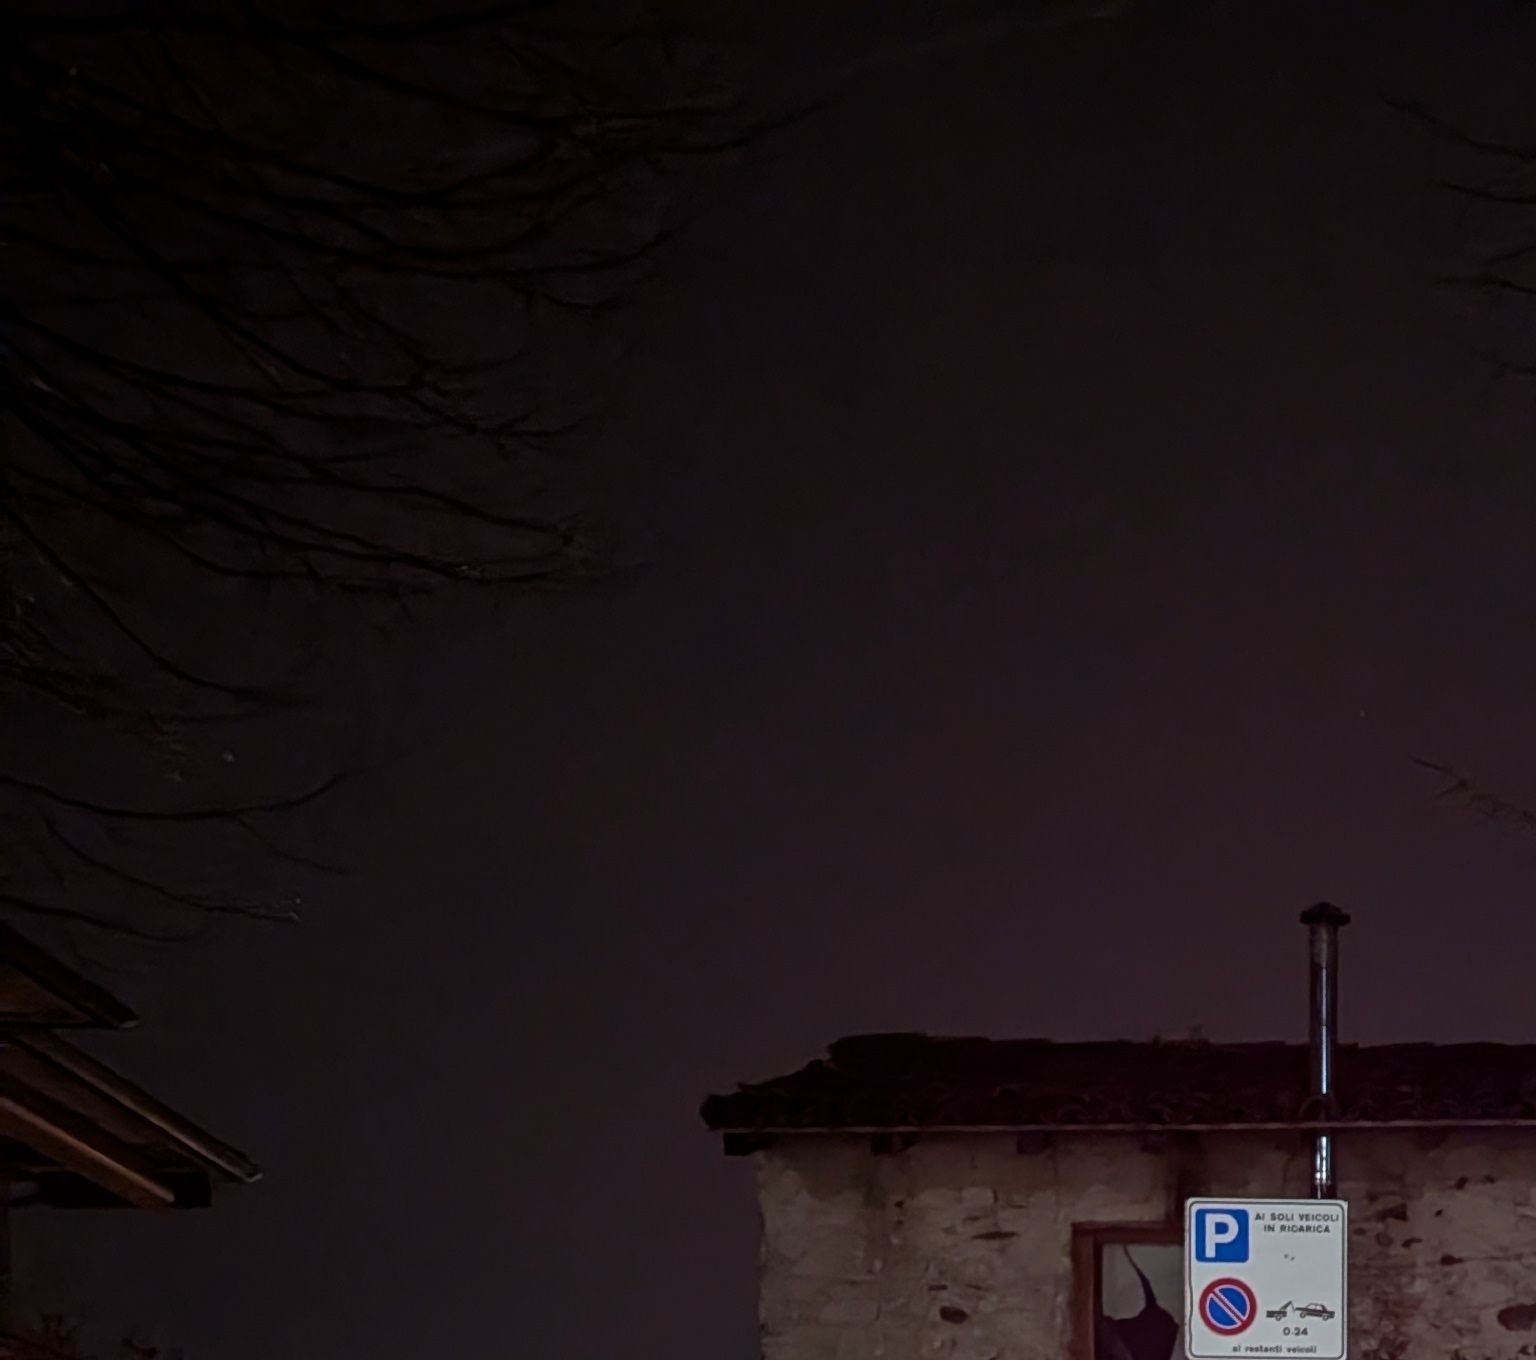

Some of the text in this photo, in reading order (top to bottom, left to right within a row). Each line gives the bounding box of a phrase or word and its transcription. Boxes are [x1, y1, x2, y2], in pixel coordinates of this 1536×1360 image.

[1255, 1212, 1339, 1222] AI SOLI VEICOLI
[1263, 1224, 1331, 1233] IN RICARICA
[1245, 1345, 1282, 1353] restanti
[1286, 1346, 1317, 1354] veicoli
